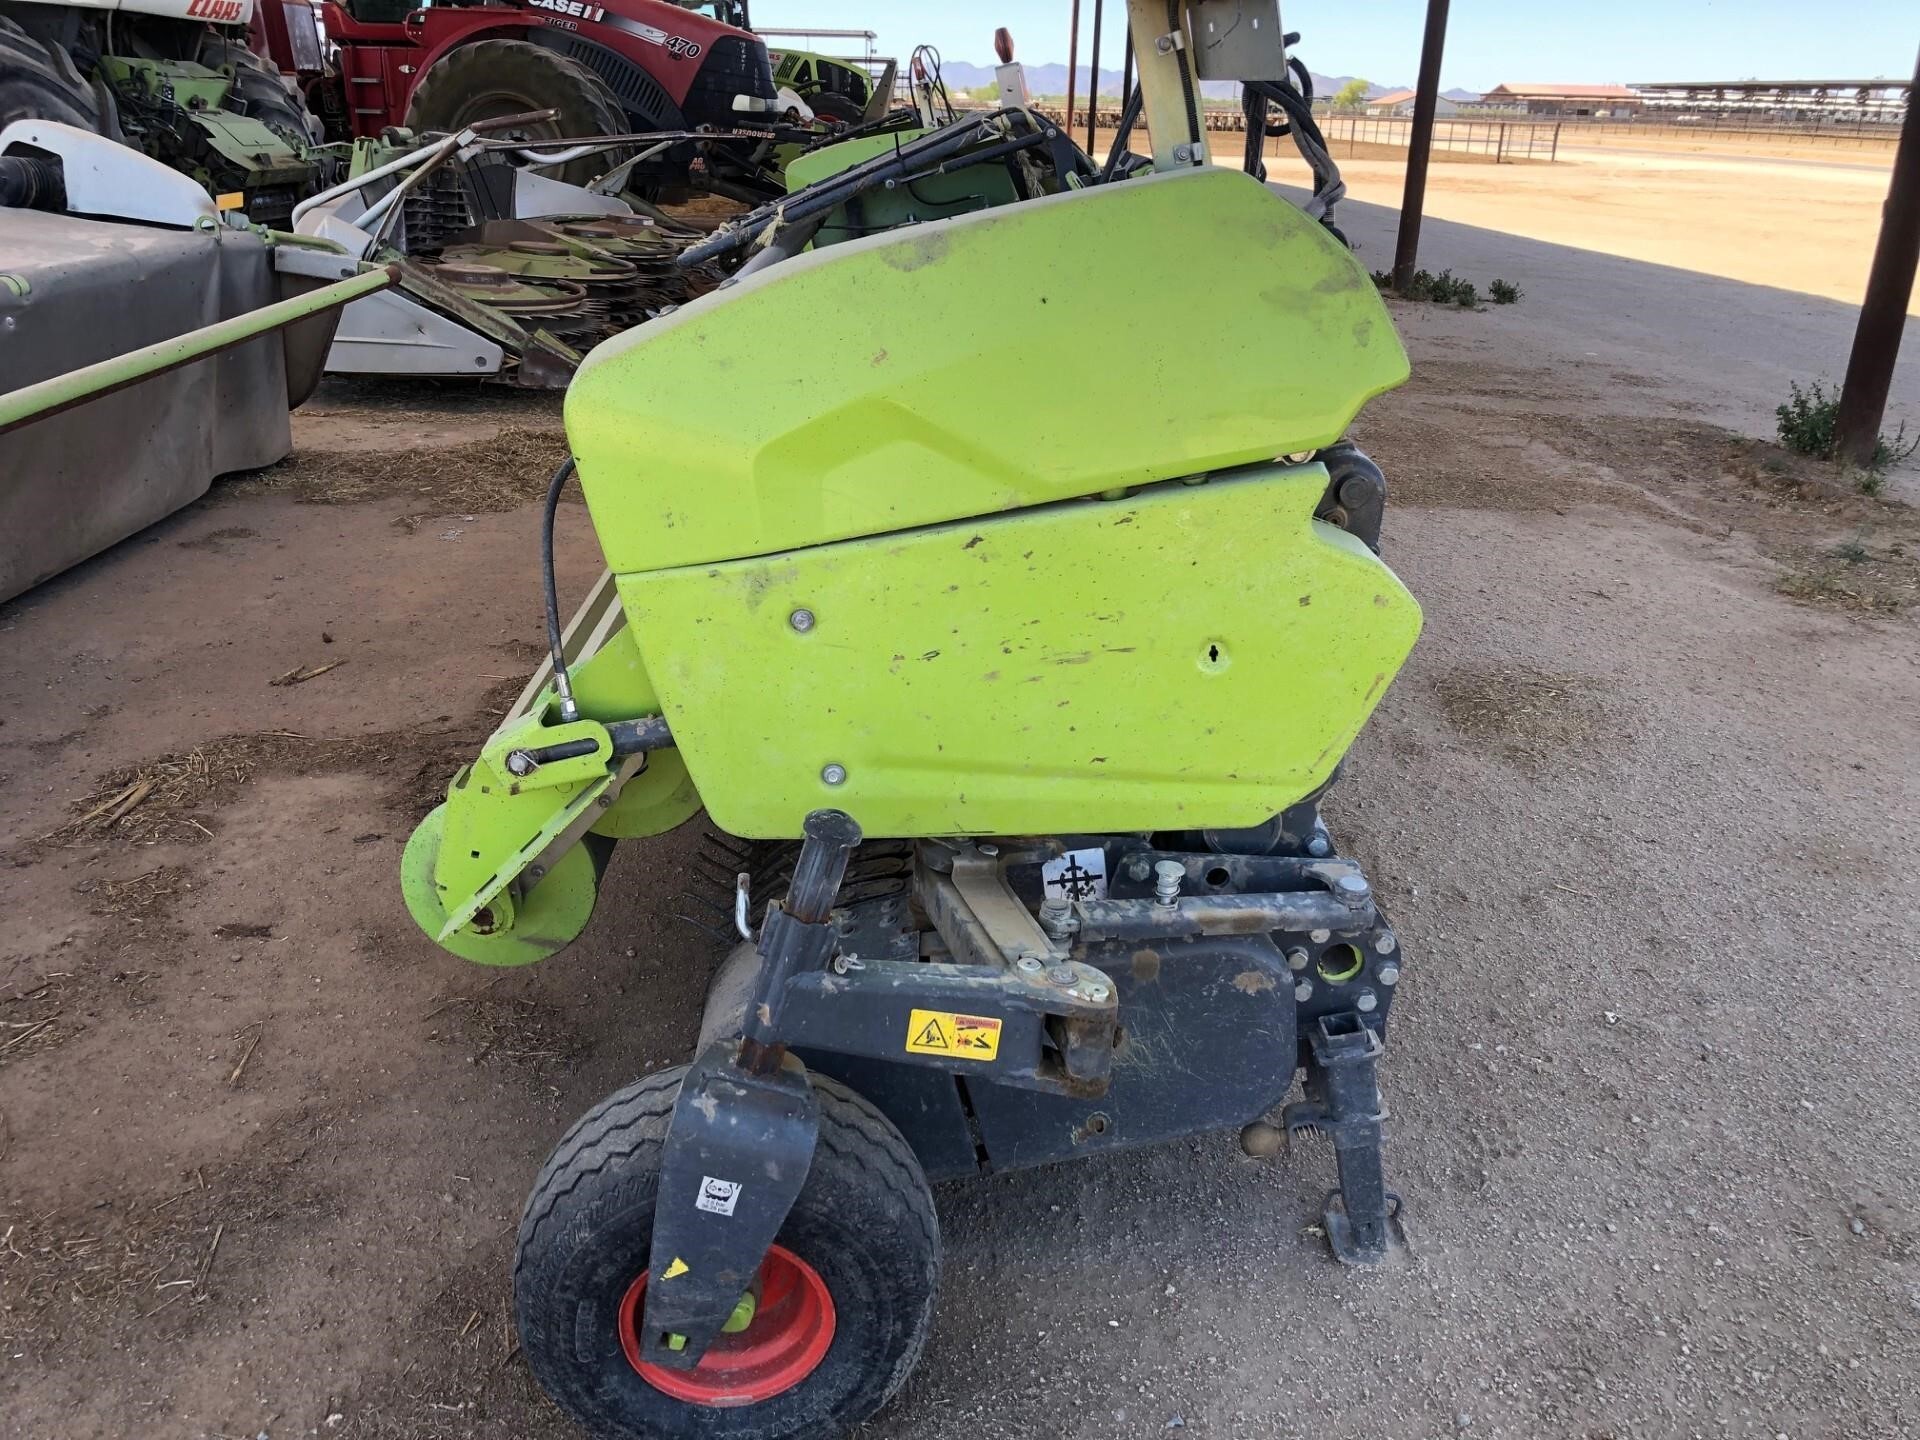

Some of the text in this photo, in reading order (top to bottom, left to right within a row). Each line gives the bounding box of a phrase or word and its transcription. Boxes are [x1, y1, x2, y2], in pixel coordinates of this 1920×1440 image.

[186, 0, 242, 21] CLAAS
[544, 15, 578, 31] EIGER
[664, 36, 701, 58] 470
